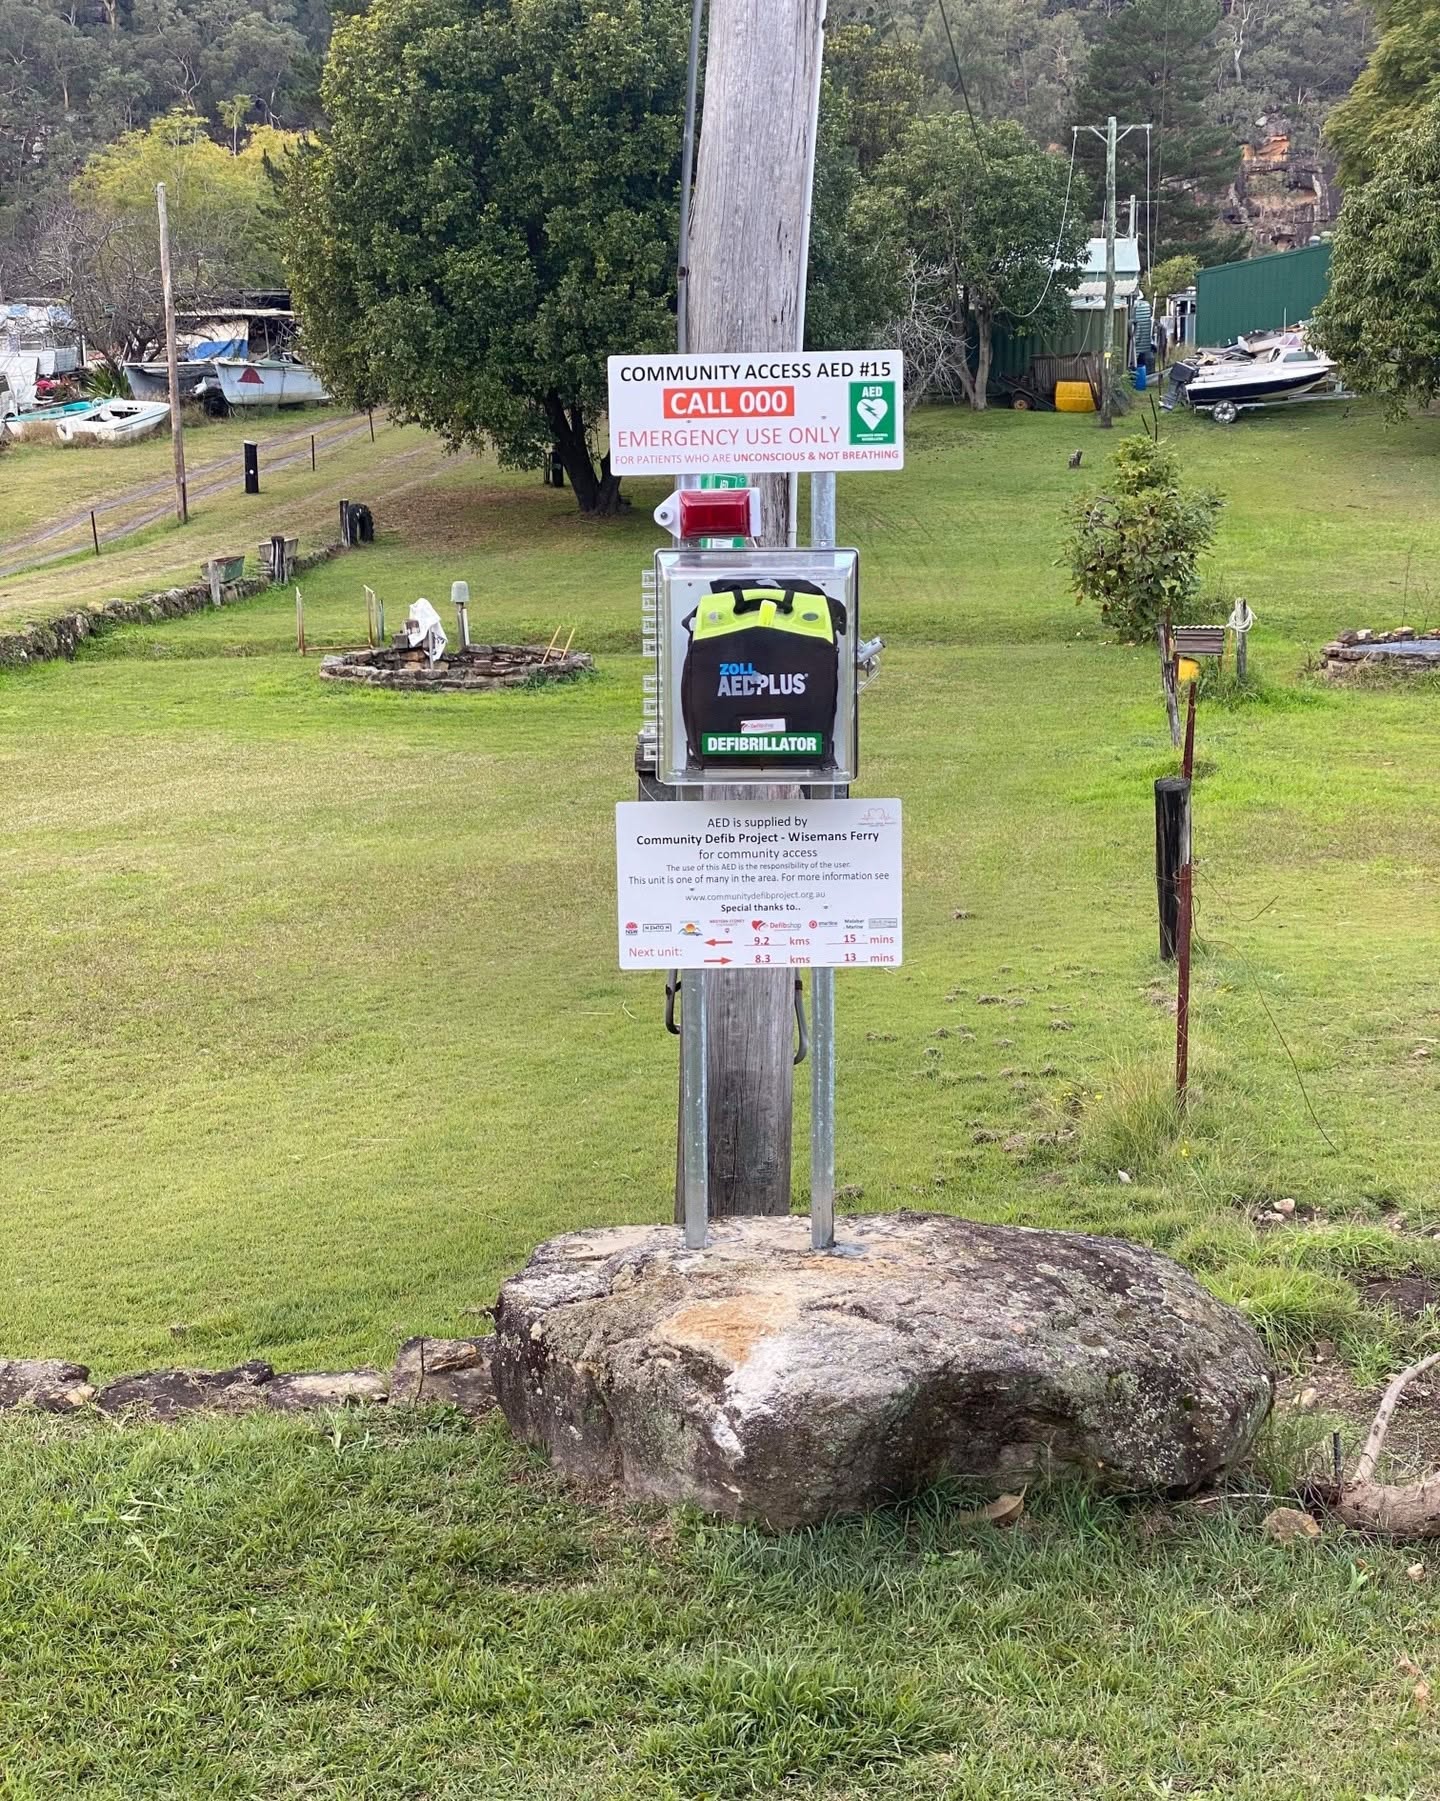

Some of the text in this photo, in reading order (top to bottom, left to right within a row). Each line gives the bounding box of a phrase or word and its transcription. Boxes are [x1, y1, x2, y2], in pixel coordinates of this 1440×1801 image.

[621, 362, 890, 382] COMMUNITY ACCESS AED #15
[862, 387, 883, 398] AED
[671, 391, 787, 414] CALL 000
[618, 429, 739, 447] EMERGENCY
[746, 428, 782, 445] USE
[789, 427, 840, 443] ONLY
[616, 450, 898, 464] FOR PATIENTS WHO ARE UNCONSCIOUS & NOT BREATHING
[720, 663, 756, 675] ZOLL
[708, 736, 817, 751] DEFIBRILLATOR
[707, 816, 808, 828] AED is supplied by
[636, 834, 702, 846] Community
[705, 832, 735, 844] Defib
[739, 832, 778, 845] Project
[789, 831, 847, 842] Wisemans
[851, 830, 879, 843] Ferry
[699, 849, 817, 860] for community access
[721, 862, 737, 870] AED
[760, 862, 808, 871] responsibility
[810, 861, 818, 869] of
[629, 875, 646, 885] This
[648, 875, 665, 884] unit
[667, 875, 674, 884] is
[695, 874, 704, 884] of
[706, 876, 729, 886] many
[731, 874, 740, 883] in
[743, 873, 756, 882] the
[782, 873, 795, 882] For
[822, 871, 872, 880] information
[686, 891, 825, 901] www.communitydefibproject.org.au
[721, 903, 800, 914] Special thanks to..
[754, 936, 810, 946] 9.2 kms
[844, 934, 894, 944] 15 mins
[628, 947, 682, 957] Next unit:
[844, 952, 894, 962] 13 mins
[754, 954, 810, 964] 8.3 kms
